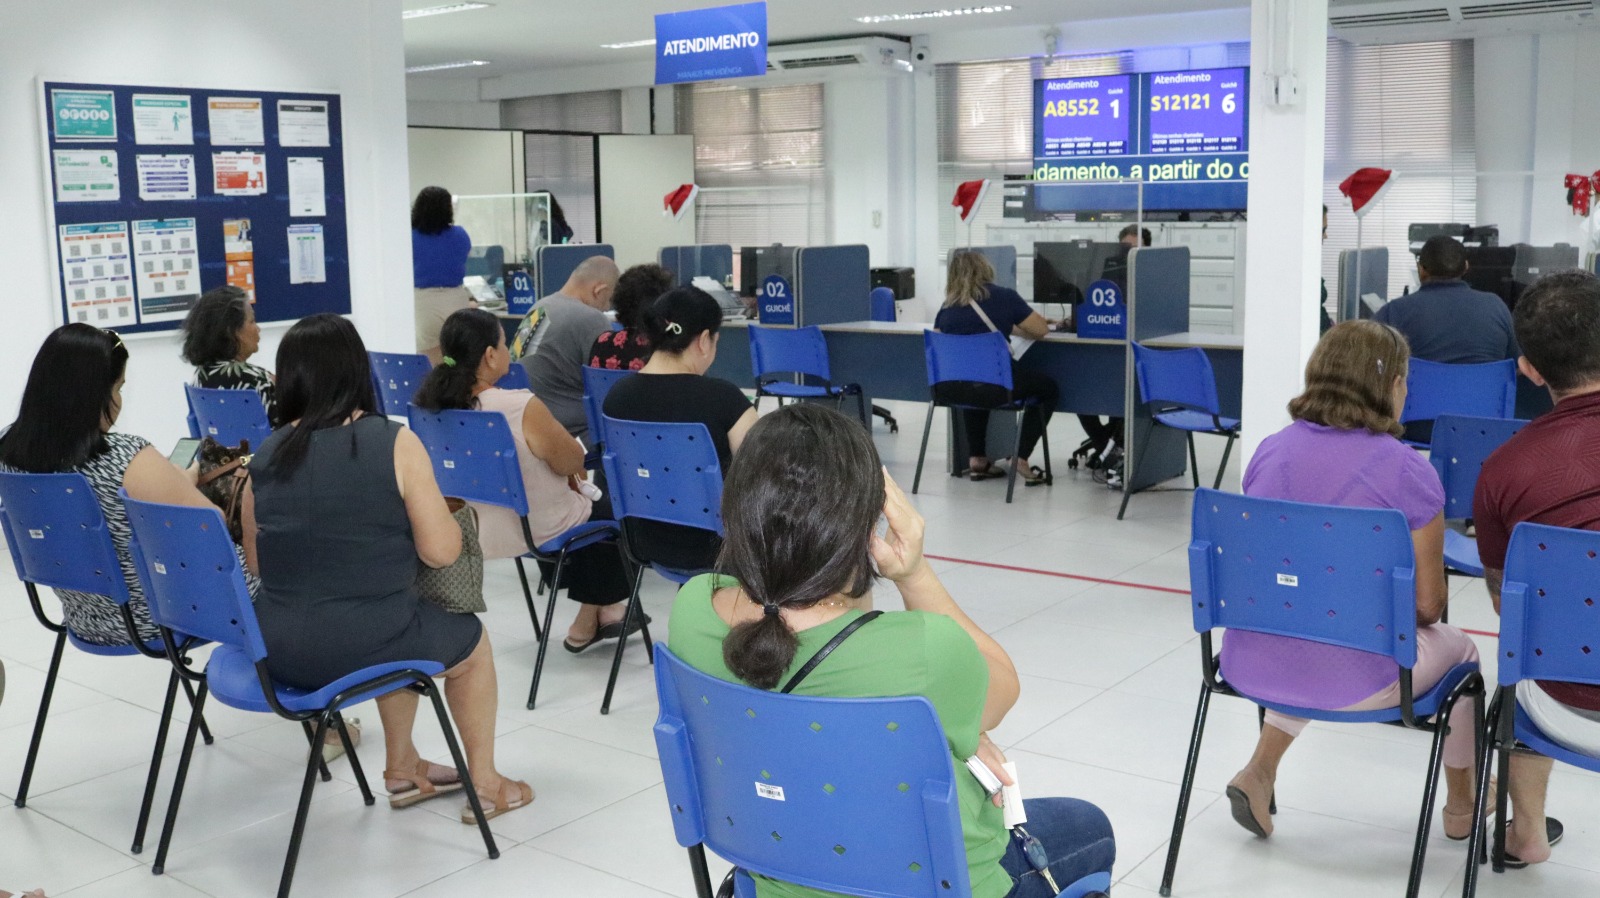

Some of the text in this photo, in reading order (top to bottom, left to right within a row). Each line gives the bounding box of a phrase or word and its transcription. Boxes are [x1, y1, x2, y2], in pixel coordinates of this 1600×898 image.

[663, 31, 759, 56] ATENDIMENTO
[1047, 80, 1099, 91] Atendimento
[1154, 73, 1211, 84] Atendimento
[1043, 98, 1099, 118] A8552
[1110, 99, 1119, 118] 1
[1151, 93, 1210, 112] S12121
[1221, 93, 1236, 114] 6
[1131, 165, 1142, 180] a
[1149, 159, 1201, 182] partir
[1207, 158, 1233, 179] do
[514, 277, 529, 290] 01
[766, 282, 785, 298] 02
[1092, 288, 1116, 306] 03
[766, 303, 791, 312] GUICHÊ
[1087, 314, 1121, 324] GUICHÊ
